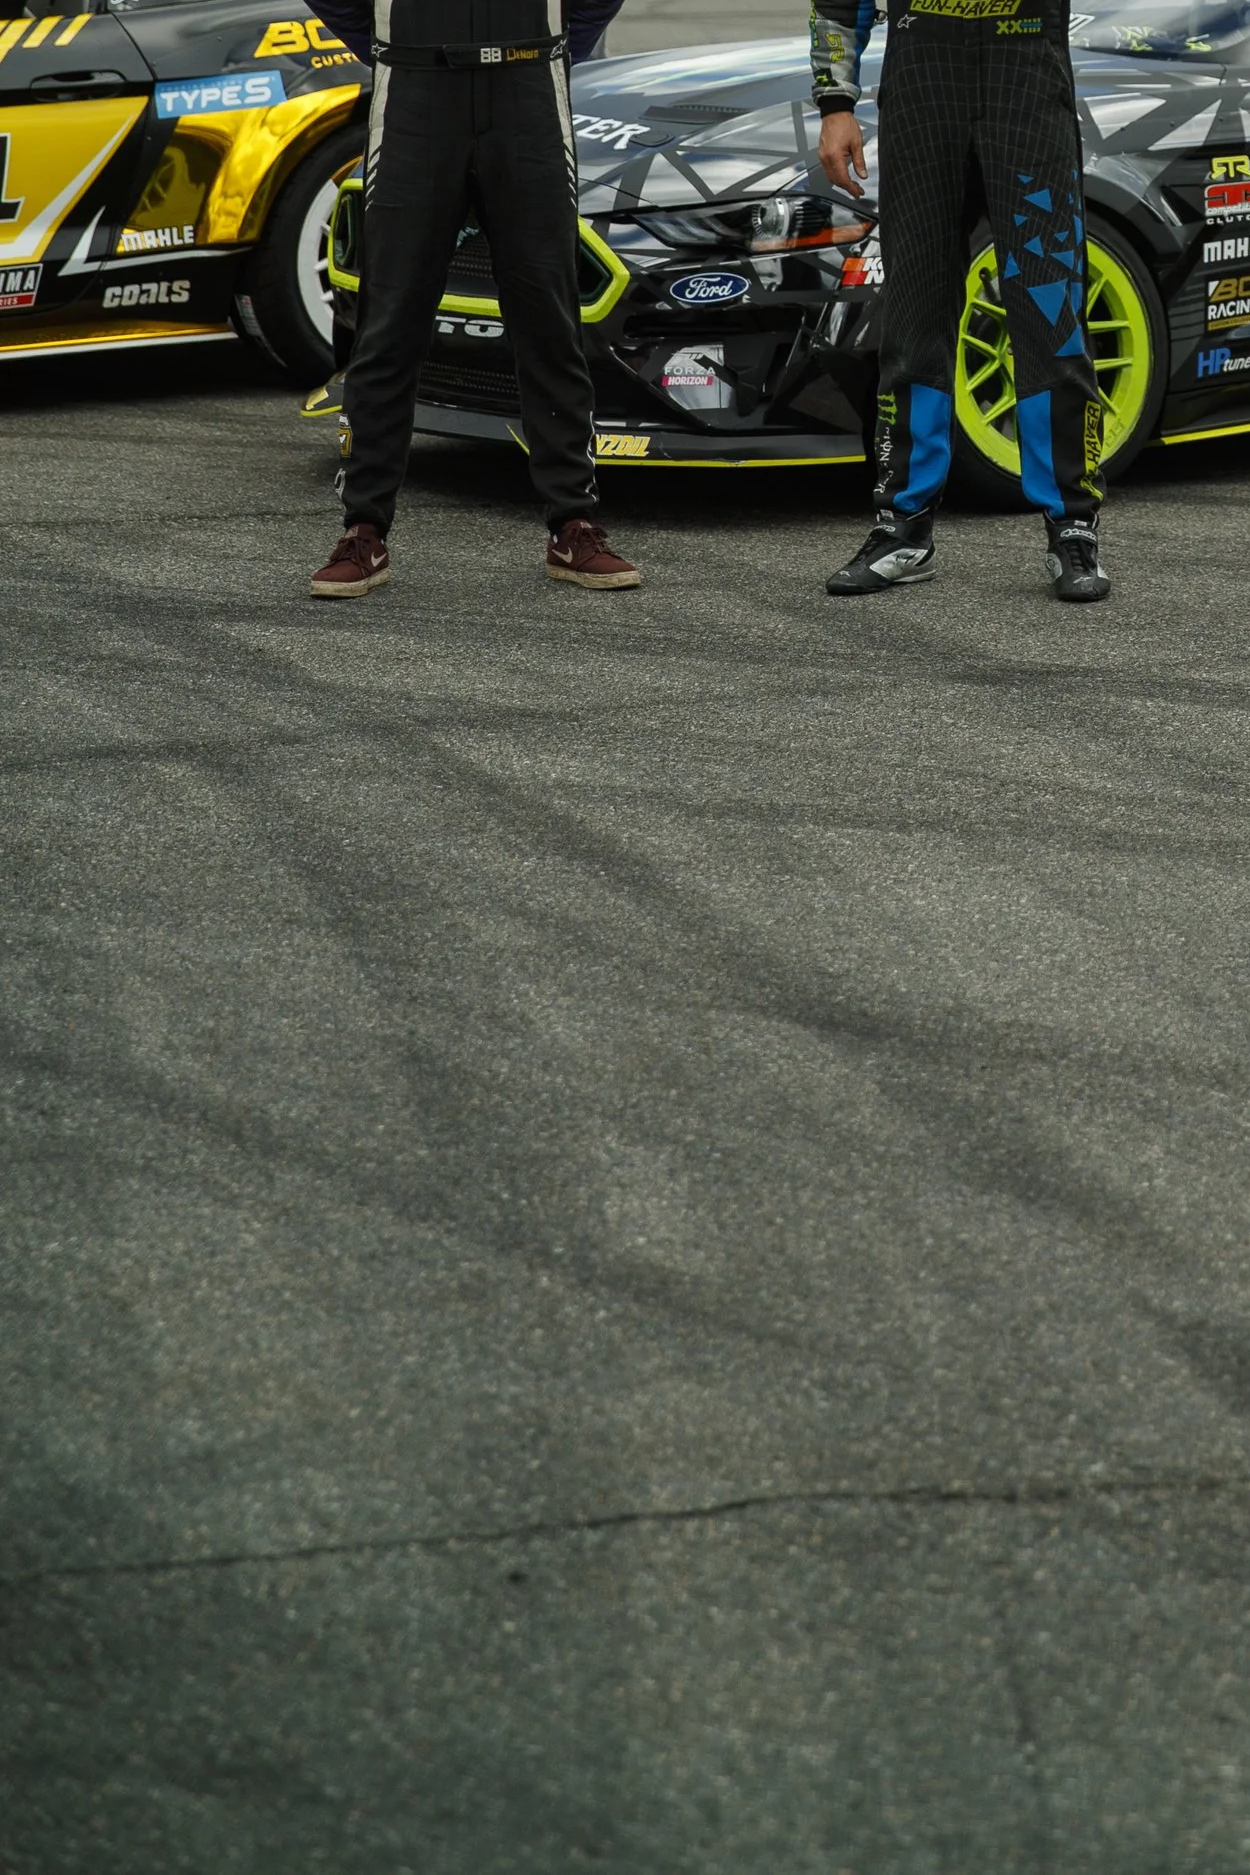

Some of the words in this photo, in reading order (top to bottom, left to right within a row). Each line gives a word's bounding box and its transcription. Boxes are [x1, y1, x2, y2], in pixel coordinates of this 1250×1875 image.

[121, 226, 194, 252] MAHLE
[685, 277, 733, 298] Ford
[664, 366, 716, 375] FORZA
[668, 376, 708, 386] HORIZON
